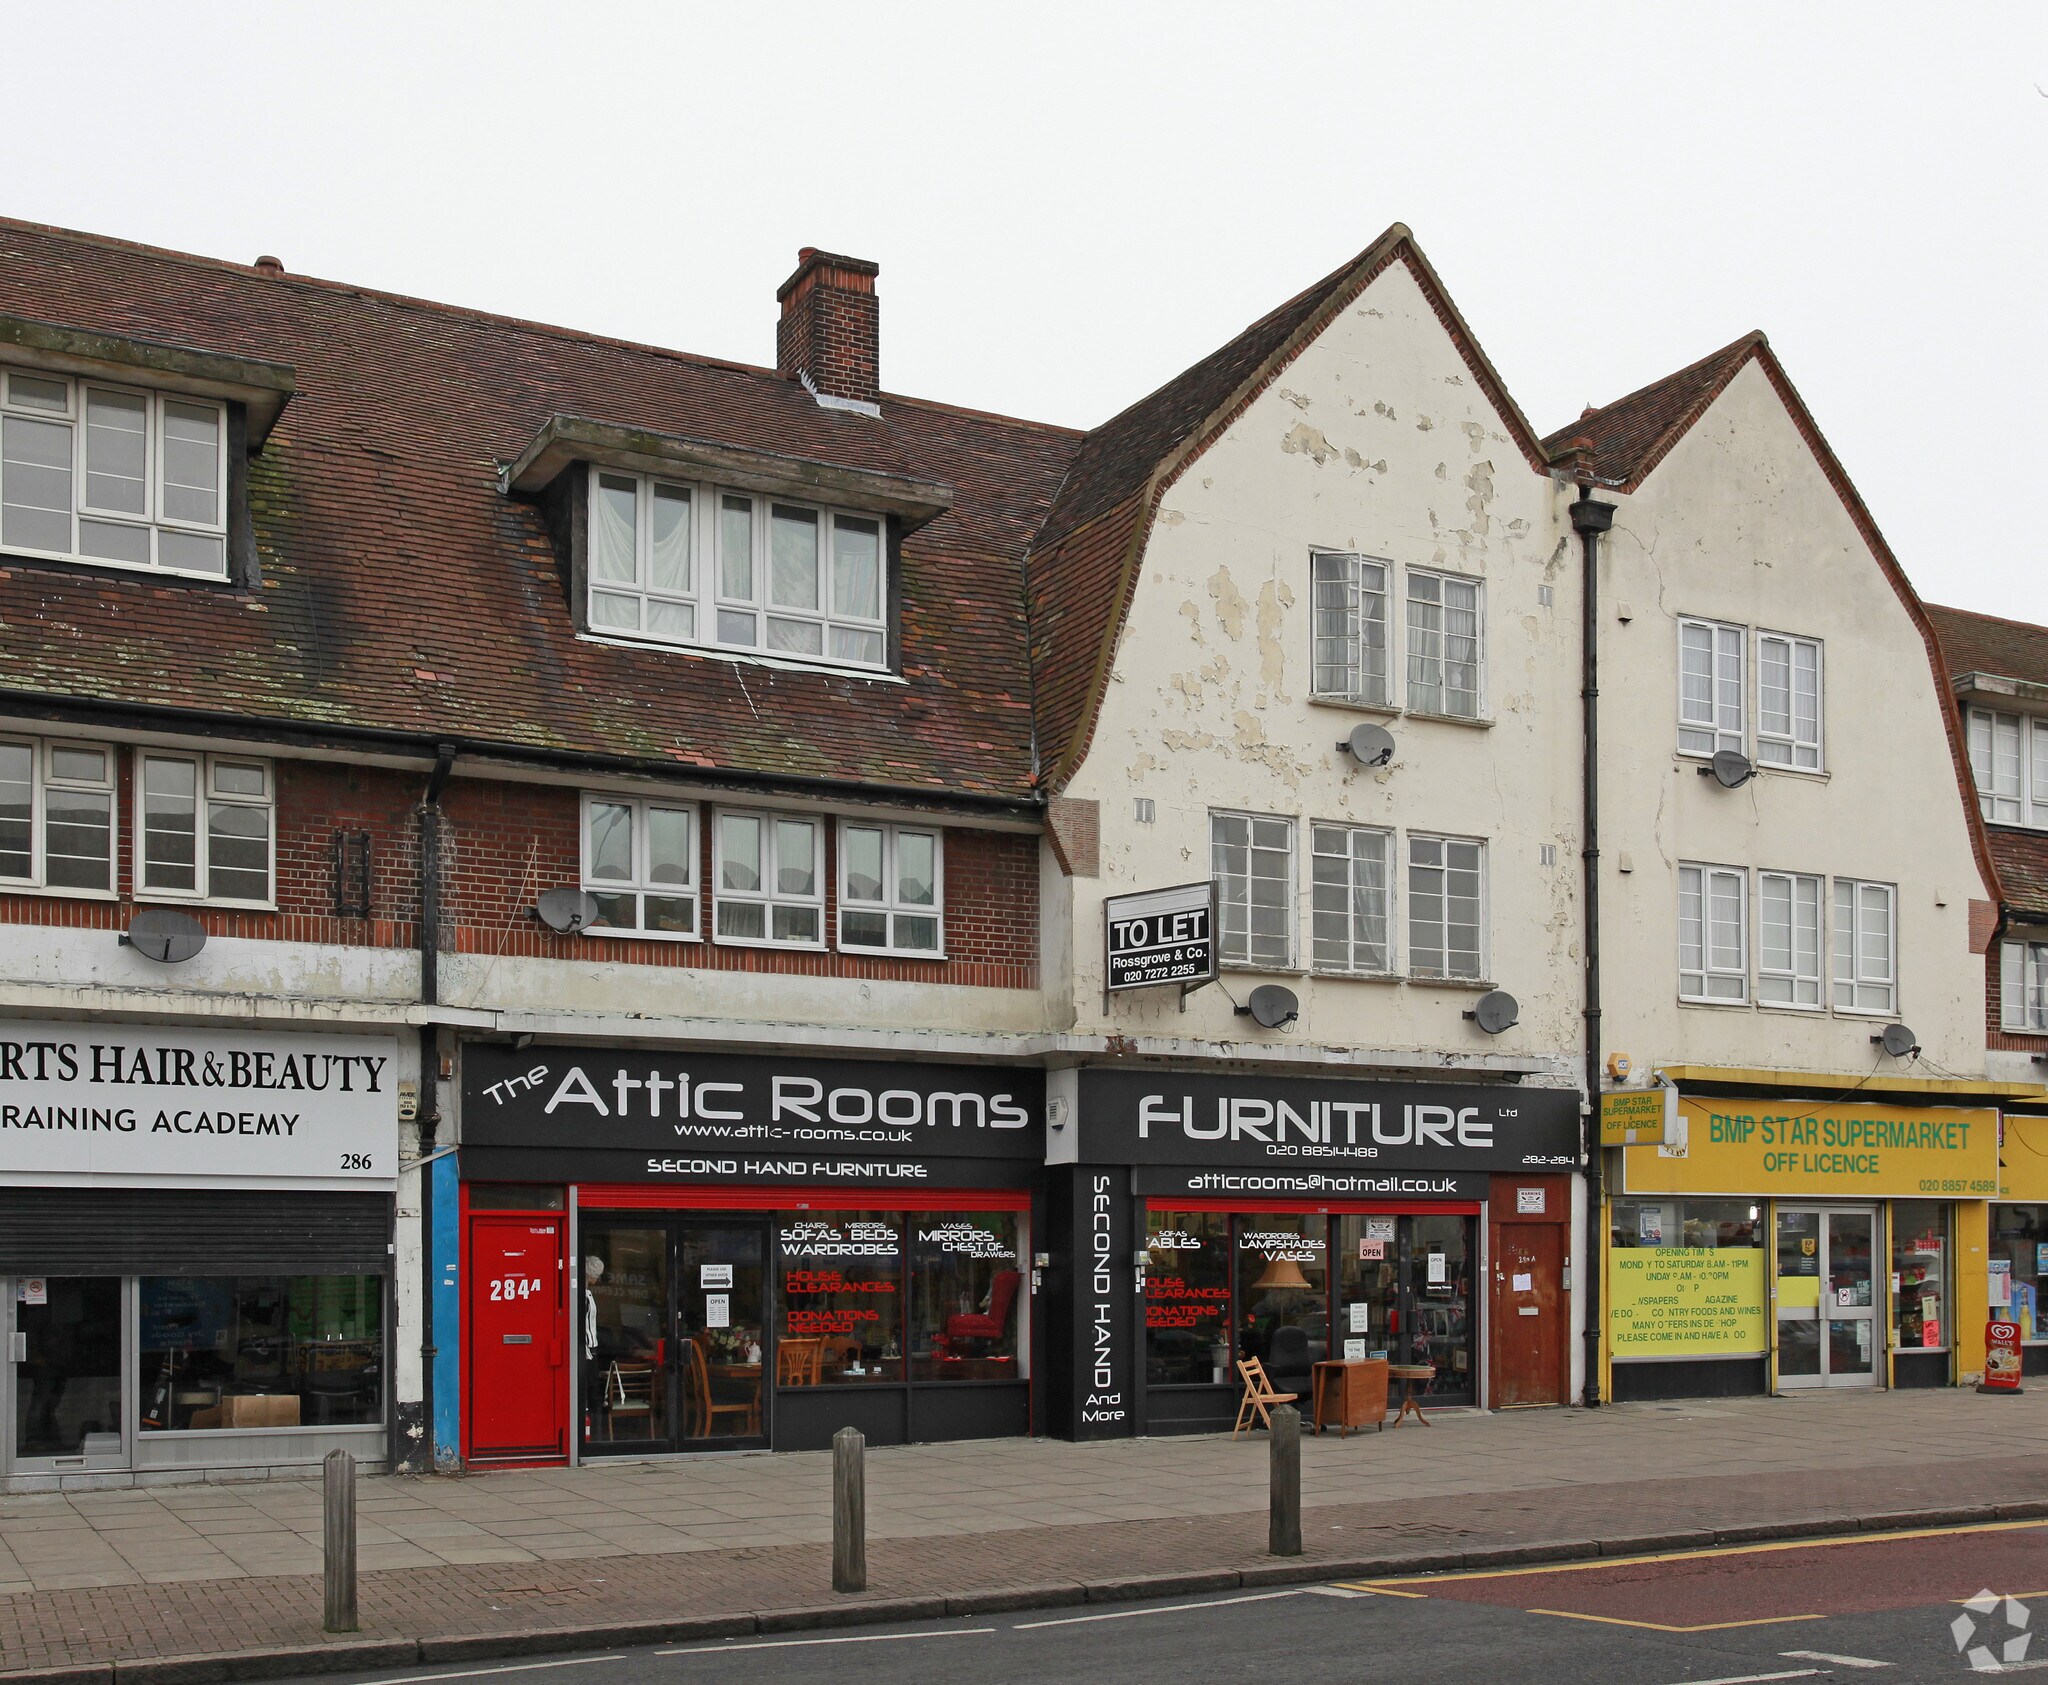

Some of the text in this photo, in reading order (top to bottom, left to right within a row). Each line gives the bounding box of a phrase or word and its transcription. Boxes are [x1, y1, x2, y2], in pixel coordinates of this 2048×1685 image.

[1114, 910, 1204, 948] TO LET
[1112, 947, 1206, 969] Rossgrove & Co.
[1124, 964, 1195, 982] 020 7272 2255
[482, 1065, 1028, 1129] The Attic Rooms
[1614, 1097, 1652, 1106] BMP STAR
[1604, 1105, 1662, 1116] SUPERMARKET
[2, 1105, 300, 1136] RAINING ACADEMY
[1139, 1094, 1518, 1148] FURNITURE Ltd
[1606, 1120, 1658, 1130] OFF LICENCE
[674, 1125, 912, 1142] www.attic-rooms.co.uk
[1710, 1114, 1756, 1144] BMP
[1762, 1116, 1818, 1147] STAR
[1823, 1120, 1970, 1149] SUPERMARKET
[1266, 1145, 1378, 1158] 020 88514488
[340, 1153, 372, 1170] 286
[1522, 1155, 1575, 1165] 282-284
[1764, 1152, 1879, 1173] OFF LICENCE
[647, 1158, 928, 1178] SECOND HAND FURNITURE
[1188, 1173, 1457, 1193] atticrooms@hotmail.co.uk
[1920, 1180, 1996, 1192] 020 8857 4589
[780, 1229, 898, 1241] SOFAS BEDS
[918, 1230, 995, 1242] MIRRORS
[781, 1243, 899, 1256] WARDROBES
[942, 1242, 1004, 1252] CHEST OF
[1240, 1240, 1326, 1249] LAMPSHADES
[1264, 1251, 1316, 1261] VASES
[1656, 1248, 1690, 1256] OPENING
[1620, 1261, 1652, 1269] MONDY
[1667, 1260, 1705, 1268] SATURDAY
[787, 1270, 842, 1282] HOUSE
[1094, 1176, 1111, 1388] SECOND HAND
[787, 1282, 895, 1293] CLEARANCES
[1147, 1278, 1184, 1288] OUSE
[490, 1279, 541, 1301] 284A
[1146, 1288, 1230, 1298] LEARANCES
[787, 1310, 880, 1322] DONATIONS
[1146, 1306, 1218, 1316] ONATIONS
[1621, 1310, 1632, 1318] DO
[1691, 1308, 1717, 1316] FOODS
[1720, 1307, 1735, 1315] AND
[1738, 1306, 1761, 1315] WINES
[787, 1321, 854, 1333] NEEDED
[1146, 1316, 1196, 1327] EEDED
[1632, 1320, 1655, 1329] MANY
[1617, 1332, 1648, 1342] PLEASE
[1650, 1332, 1672, 1340] COME
[1674, 1332, 1682, 1340] IN
[1684, 1332, 1700, 1340] AND
[1702, 1331, 1720, 1339] HAVE
[1723, 1330, 1728, 1338] A
[1086, 1393, 1121, 1406] And
[1082, 1410, 1125, 1422] More
